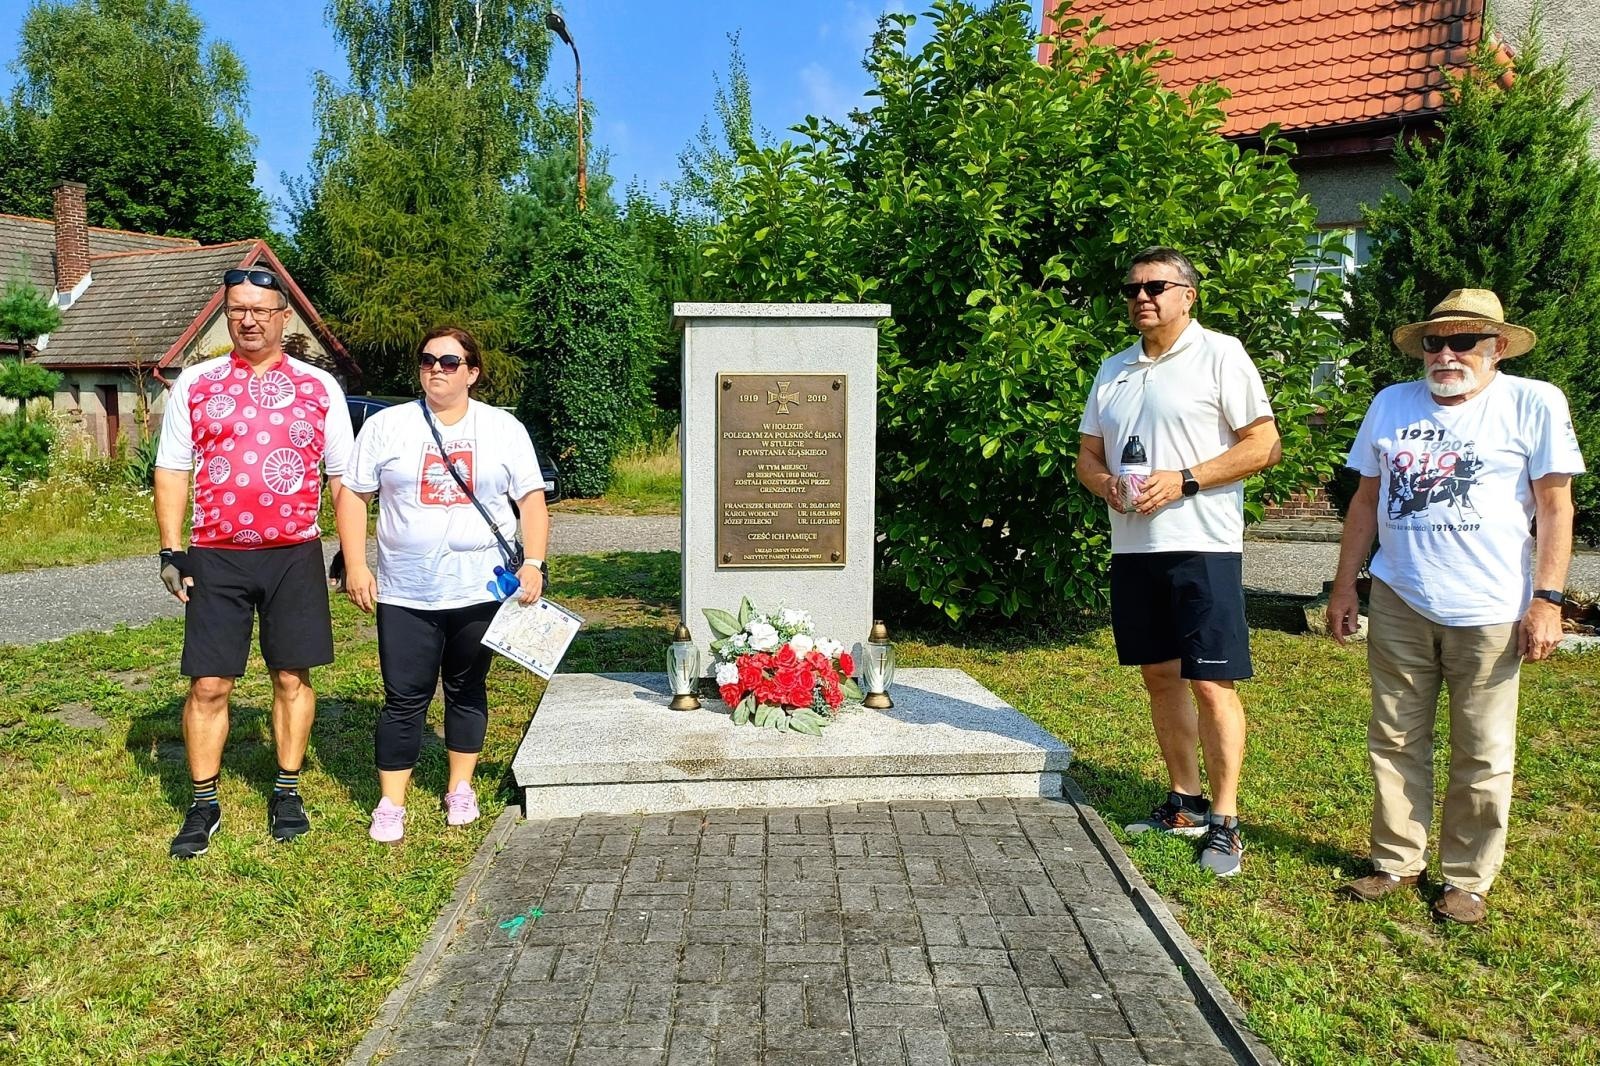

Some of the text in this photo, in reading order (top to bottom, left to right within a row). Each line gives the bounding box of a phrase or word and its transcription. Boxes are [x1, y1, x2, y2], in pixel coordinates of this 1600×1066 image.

[739, 394, 759, 402] 1919
[807, 394, 828, 402] 2019
[723, 430, 842, 440] POLEGŁYM ZA POLSKOŚĆ ŚLĄSKA
[1401, 429, 1445, 441] 1921
[1423, 440, 1462, 453] 1920
[787, 448, 828, 457] ŚLĄSKIEGO
[723, 517, 744, 525] JÓZEF
[1431, 523, 1480, 532] 1919-2019
[747, 532, 771, 540] CZEŚĆ
